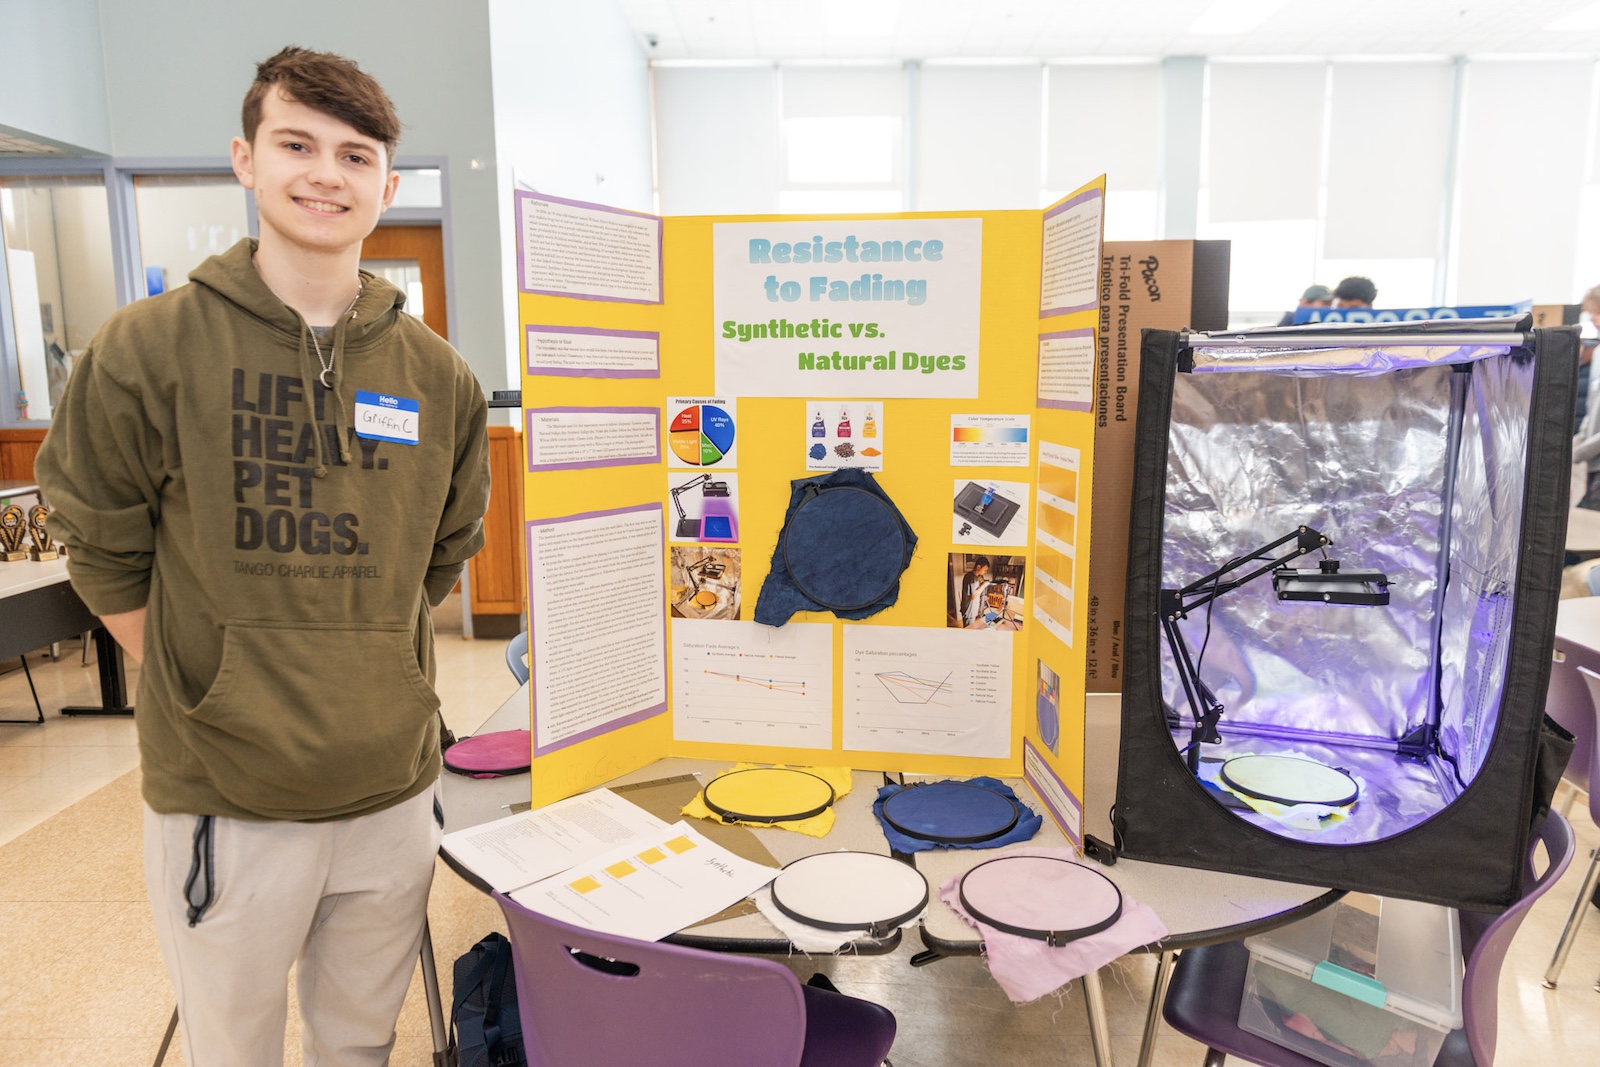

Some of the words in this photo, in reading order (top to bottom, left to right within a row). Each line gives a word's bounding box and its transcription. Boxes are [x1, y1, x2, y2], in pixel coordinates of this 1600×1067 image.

[748, 235, 944, 264] Resistance
[764, 275, 801, 302] to
[809, 274, 927, 306] Fading
[1119, 255, 1131, 301] Tri-Fold
[1139, 255, 1161, 302] Pacon
[722, 318, 843, 342] Synthetic
[848, 323, 886, 338] vs.
[1101, 306, 1110, 332] para
[1117, 305, 1130, 381] Presentation
[798, 350, 896, 371] Natural
[902, 352, 966, 374] Dyes
[232, 368, 332, 421] LIFT
[1099, 337, 1111, 427] presentaciones
[379, 396, 398, 405] Hello
[1116, 386, 1127, 422] Board
[363, 410, 400, 432] Griffin
[403, 418, 412, 433] C
[232, 414, 389, 470] HEAVY.
[233, 461, 313, 508] PET
[235, 507, 369, 555] DOGS.
[233, 561, 274, 576] TANGO
[278, 563, 329, 578] CHARLIE
[332, 565, 381, 578] APPAREL
